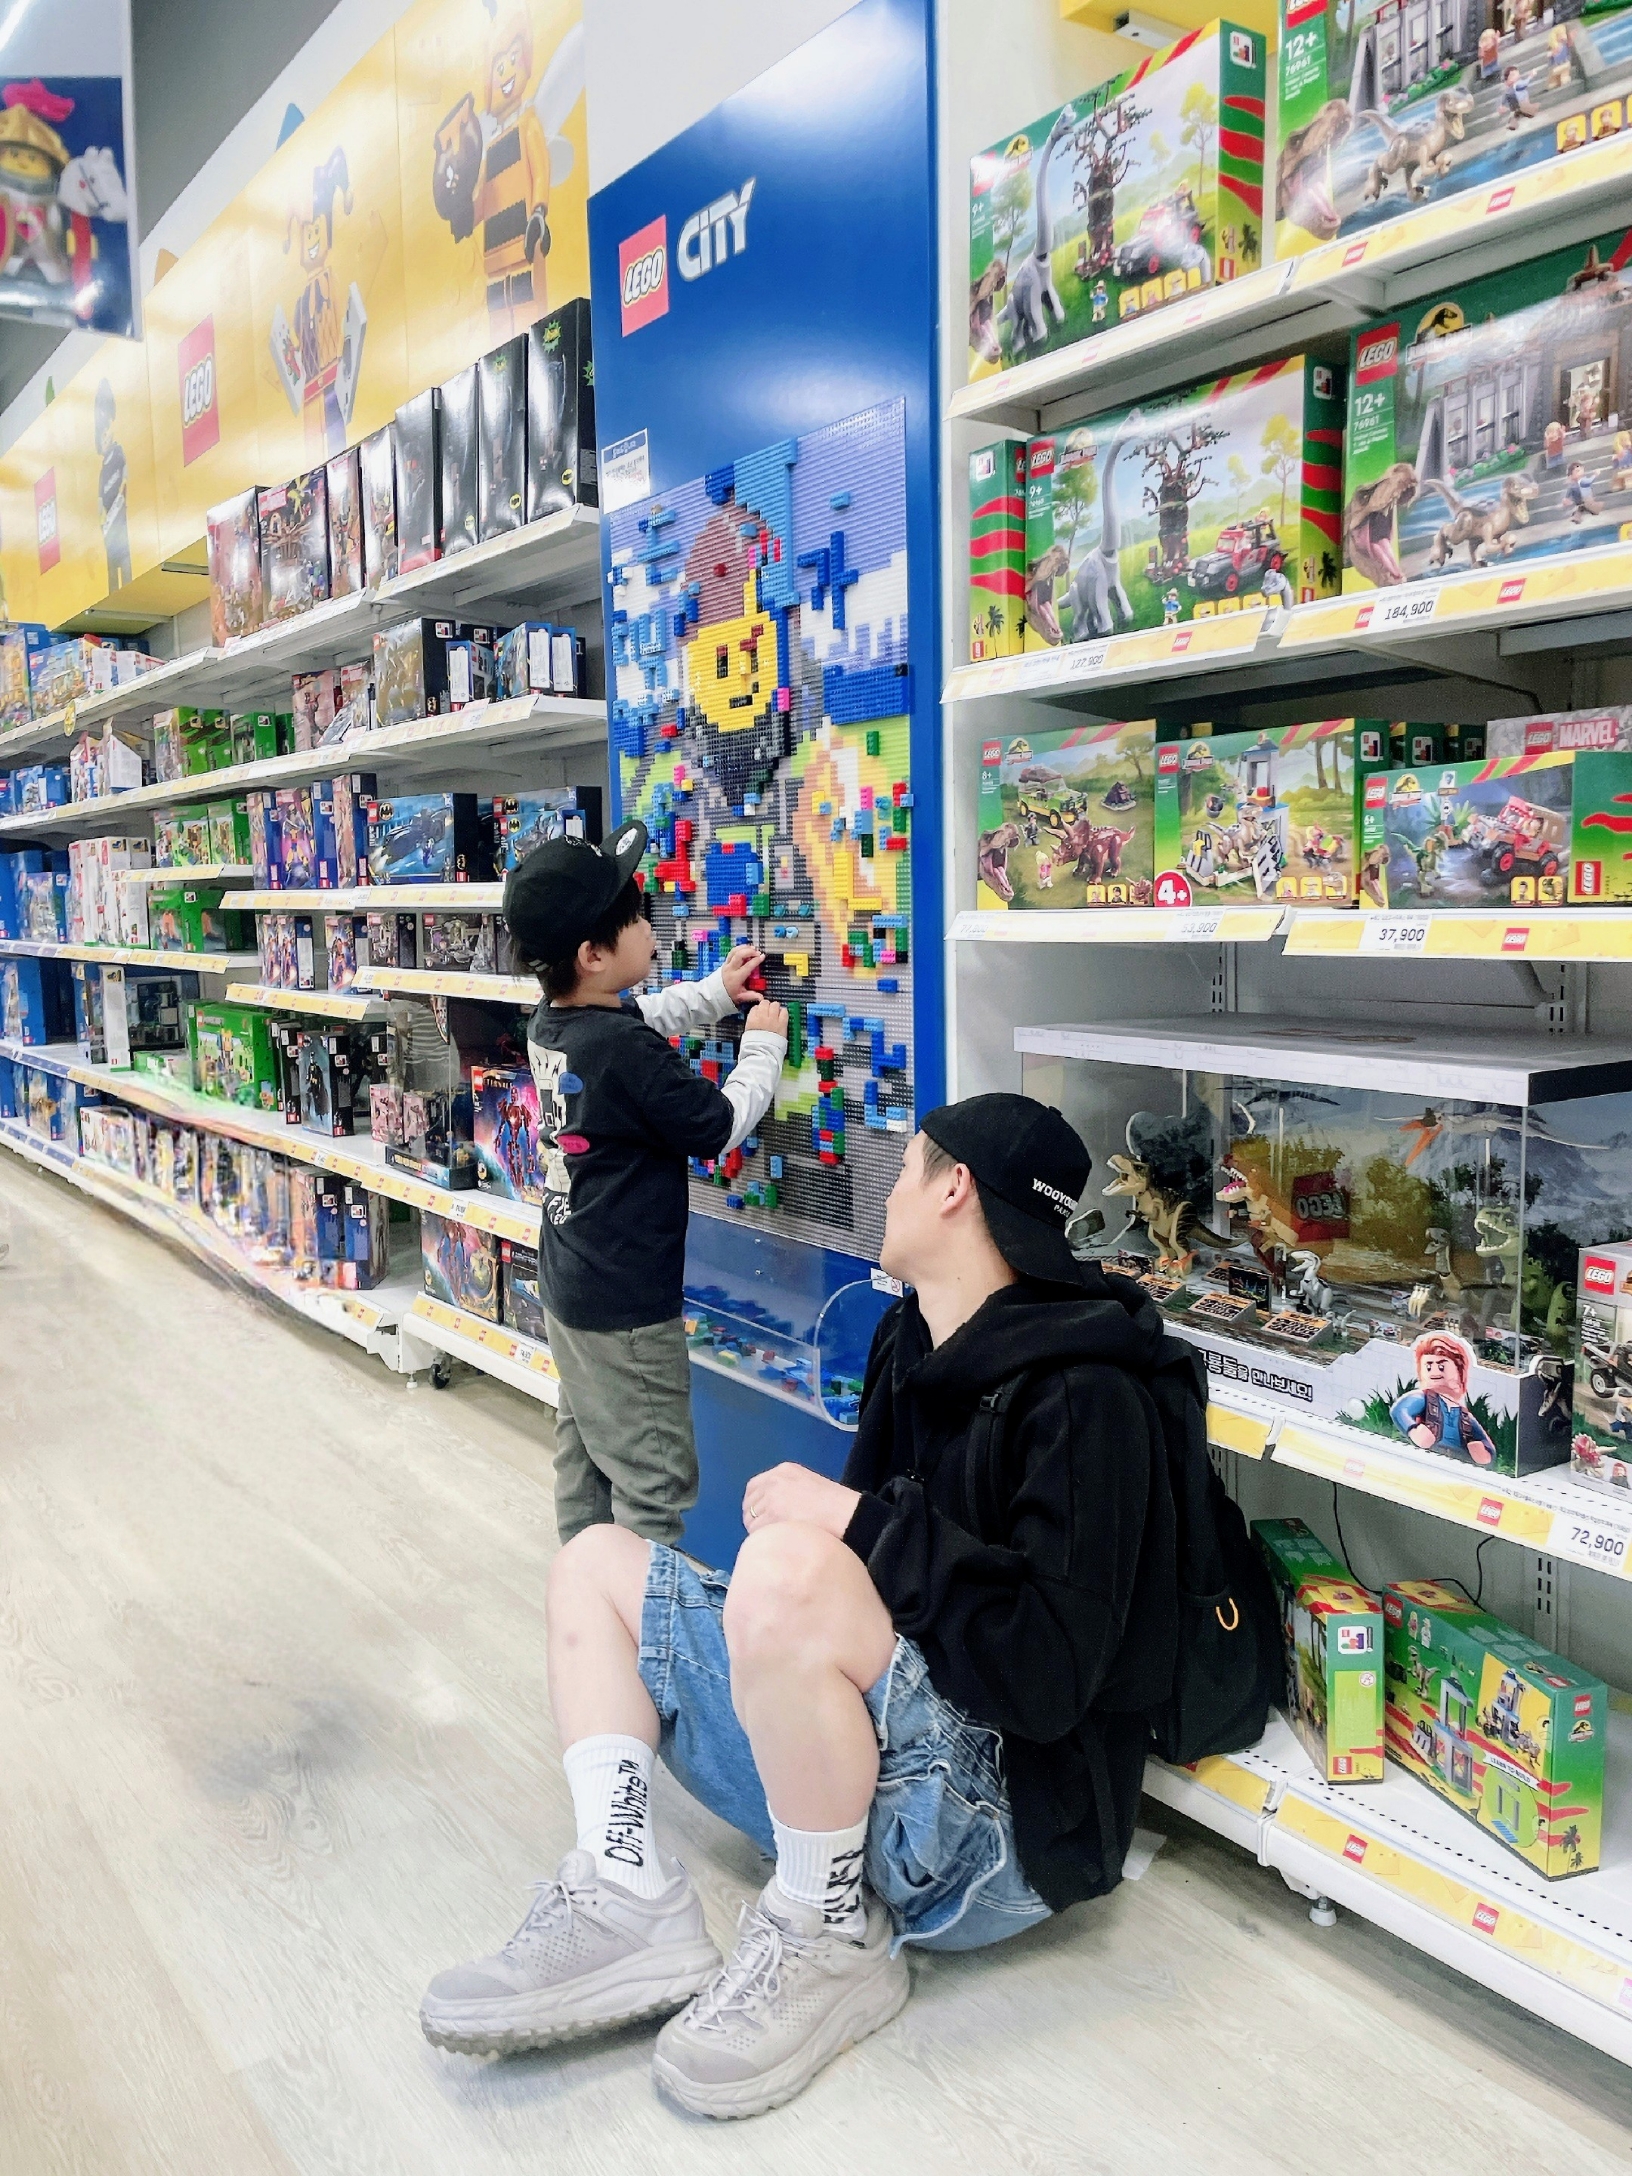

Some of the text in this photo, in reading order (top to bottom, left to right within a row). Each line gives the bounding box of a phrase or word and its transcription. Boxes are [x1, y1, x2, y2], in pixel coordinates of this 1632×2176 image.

[1286, 31, 1319, 60] 12+
[623, 175, 757, 304] LEGO CITY
[1358, 340, 1395, 369] LEGO
[184, 354, 213, 428] LEGO
[1355, 393, 1386, 417] 12+
[1029, 485, 1042, 498] 9+
[1384, 600, 1434, 620] 184,900
[1528, 720, 1616, 748] LEGO MARVEL
[1157, 879, 1188, 905] 4+
[1582, 863, 1594, 895] LEGO
[1379, 928, 1425, 943] 37,900
[1586, 1267, 1613, 1284] LEGO
[1583, 1304, 1597, 1317] 7+
[1571, 1526, 1624, 1556] 72,900
